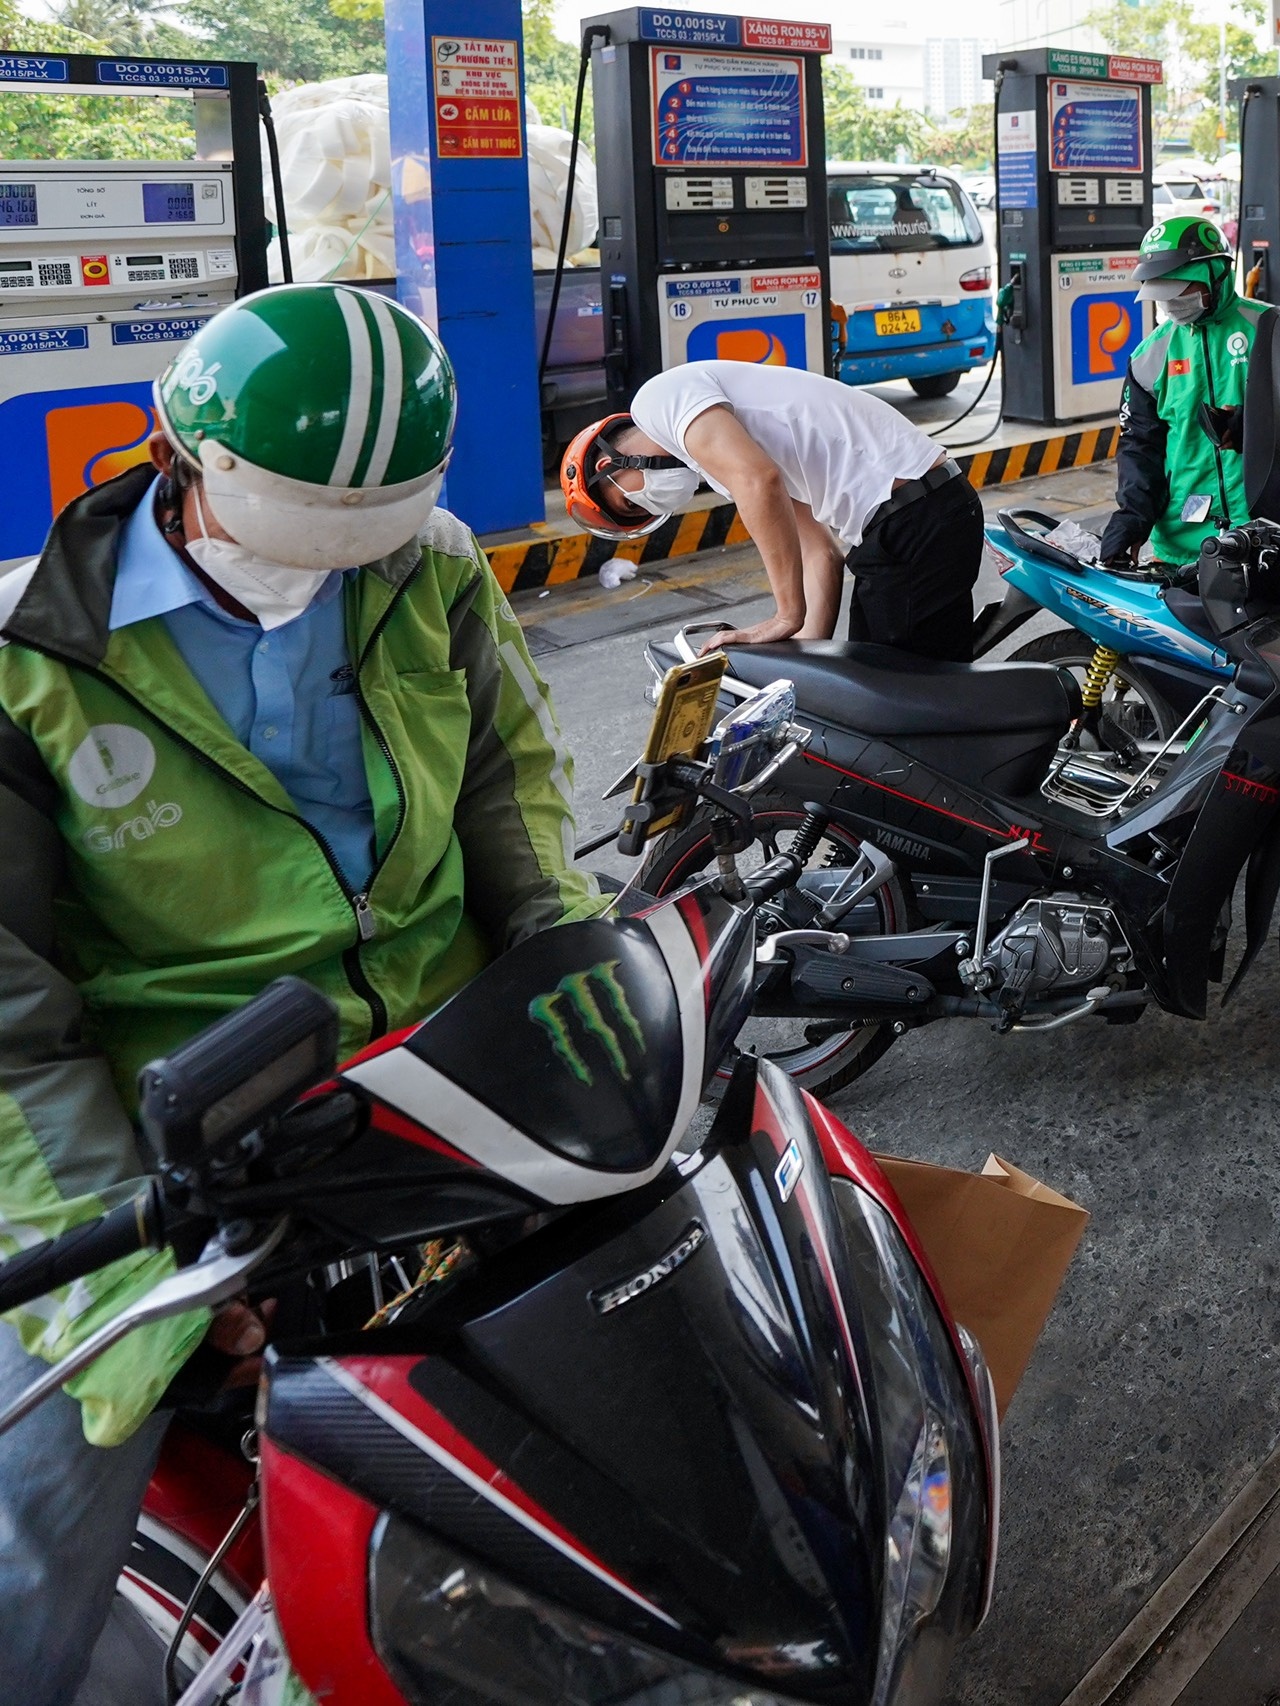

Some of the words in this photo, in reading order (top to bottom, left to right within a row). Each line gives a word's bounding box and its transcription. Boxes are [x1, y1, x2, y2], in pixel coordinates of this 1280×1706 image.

[653, 14, 672, 26] DO
[674, 16, 726, 31] 0,001S-V
[656, 29, 677, 39] TCCS
[678, 30, 688, 39] 03
[781, 25, 803, 37] RON
[805, 28, 827, 39] 95-V
[116, 64, 139, 74] DO
[143, 66, 209, 76] 0,001S-V
[119, 74, 146, 82] TCCS
[169, 75, 211, 84] 2015/PLX
[676, 282, 690, 290] DO
[781, 277, 797, 285] RON
[1062, 277, 1070, 287] 18
[806, 292, 817, 305] 17
[673, 303, 686, 317] 16
[131, 324, 154, 333] DO
[158, 320, 206, 332] 0,001S
[133, 332, 160, 341] TCCS
[163, 331, 174, 339] 03
[21, 340, 69, 351] 2015/PLX
[83, 799, 183, 853] Grab
[876, 828, 930, 860] YAMAHA
[600, 1228, 703, 1314] HONDA
